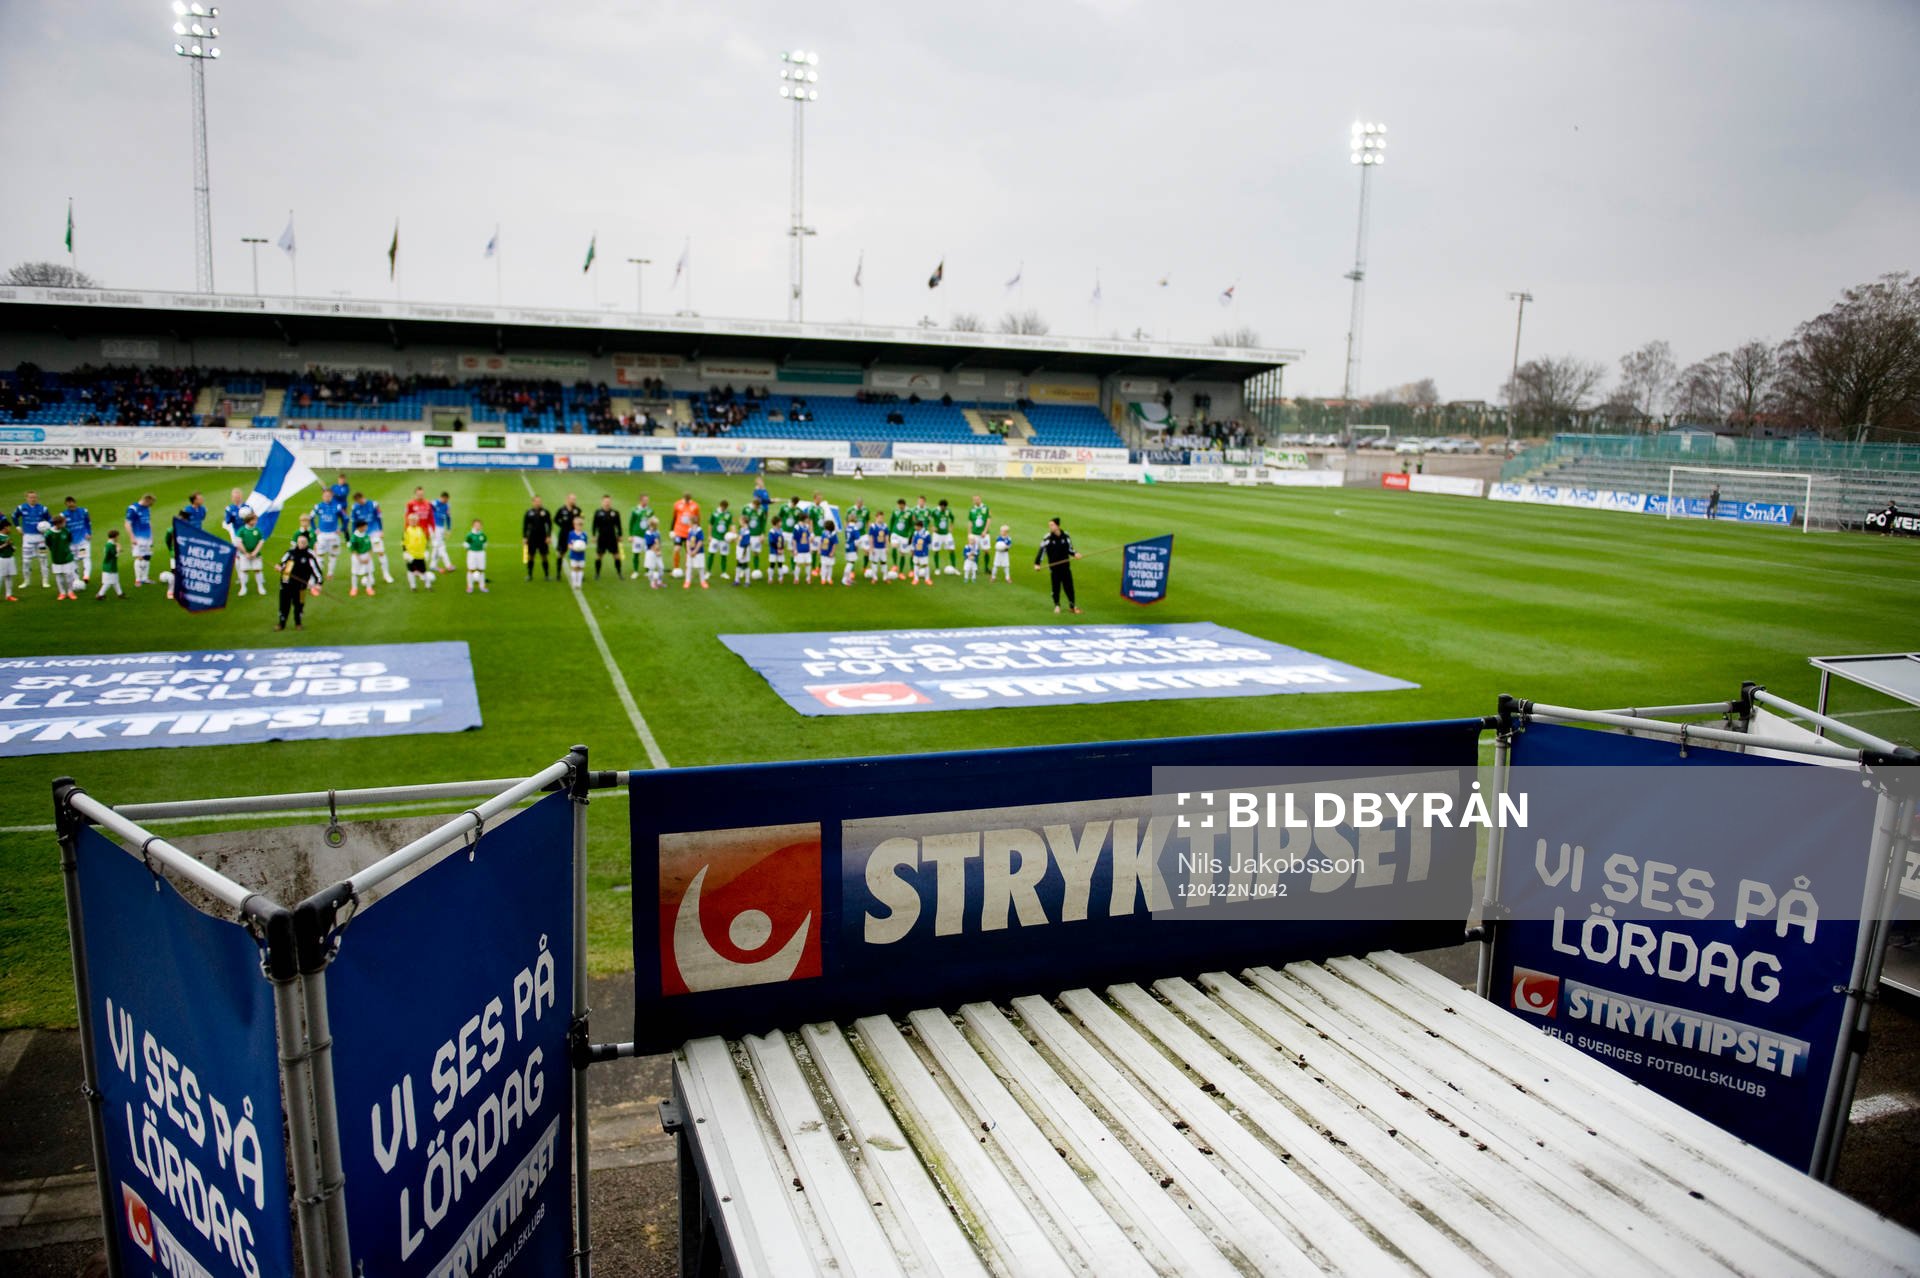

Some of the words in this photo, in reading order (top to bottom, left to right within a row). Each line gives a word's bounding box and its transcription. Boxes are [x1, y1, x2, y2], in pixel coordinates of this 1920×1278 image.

[14, 448, 68, 457] LARSSON
[73, 447, 117, 463] MVB
[151, 450, 224, 462] INTERSPORT
[894, 460, 934, 475] Nilpat
[1018, 448, 1067, 460] TRETAB
[203, 653, 235, 662] IN
[801, 647, 1272, 677] FOTBOLLSKLUBB
[803, 643, 956, 660] HELA
[10, 661, 388, 690] SVERIGES
[939, 665, 1350, 700] STRYKTIPSET
[864, 792, 1436, 945] STRYKTIPSET
[1535, 838, 1585, 893] VI
[1602, 853, 1716, 921] SES
[1734, 875, 1820, 944] PÅ
[1552, 903, 1783, 1003] LÖRDAG
[1568, 988, 1802, 1078] STRYKTIPSET
[371, 1073, 418, 1174] VI
[431, 996, 505, 1122] SES
[513, 933, 554, 1041] PÅ
[1578, 1037, 1643, 1065] SVERIGES
[1647, 1056, 1767, 1098] FOTBOLLSKLUBB
[106, 997, 136, 1084] VI
[143, 1030, 206, 1148] SES
[208, 1093, 265, 1211] PÅ
[400, 1045, 545, 1262] LÖRDAG
[126, 1101, 261, 1278] LÖRDAG
